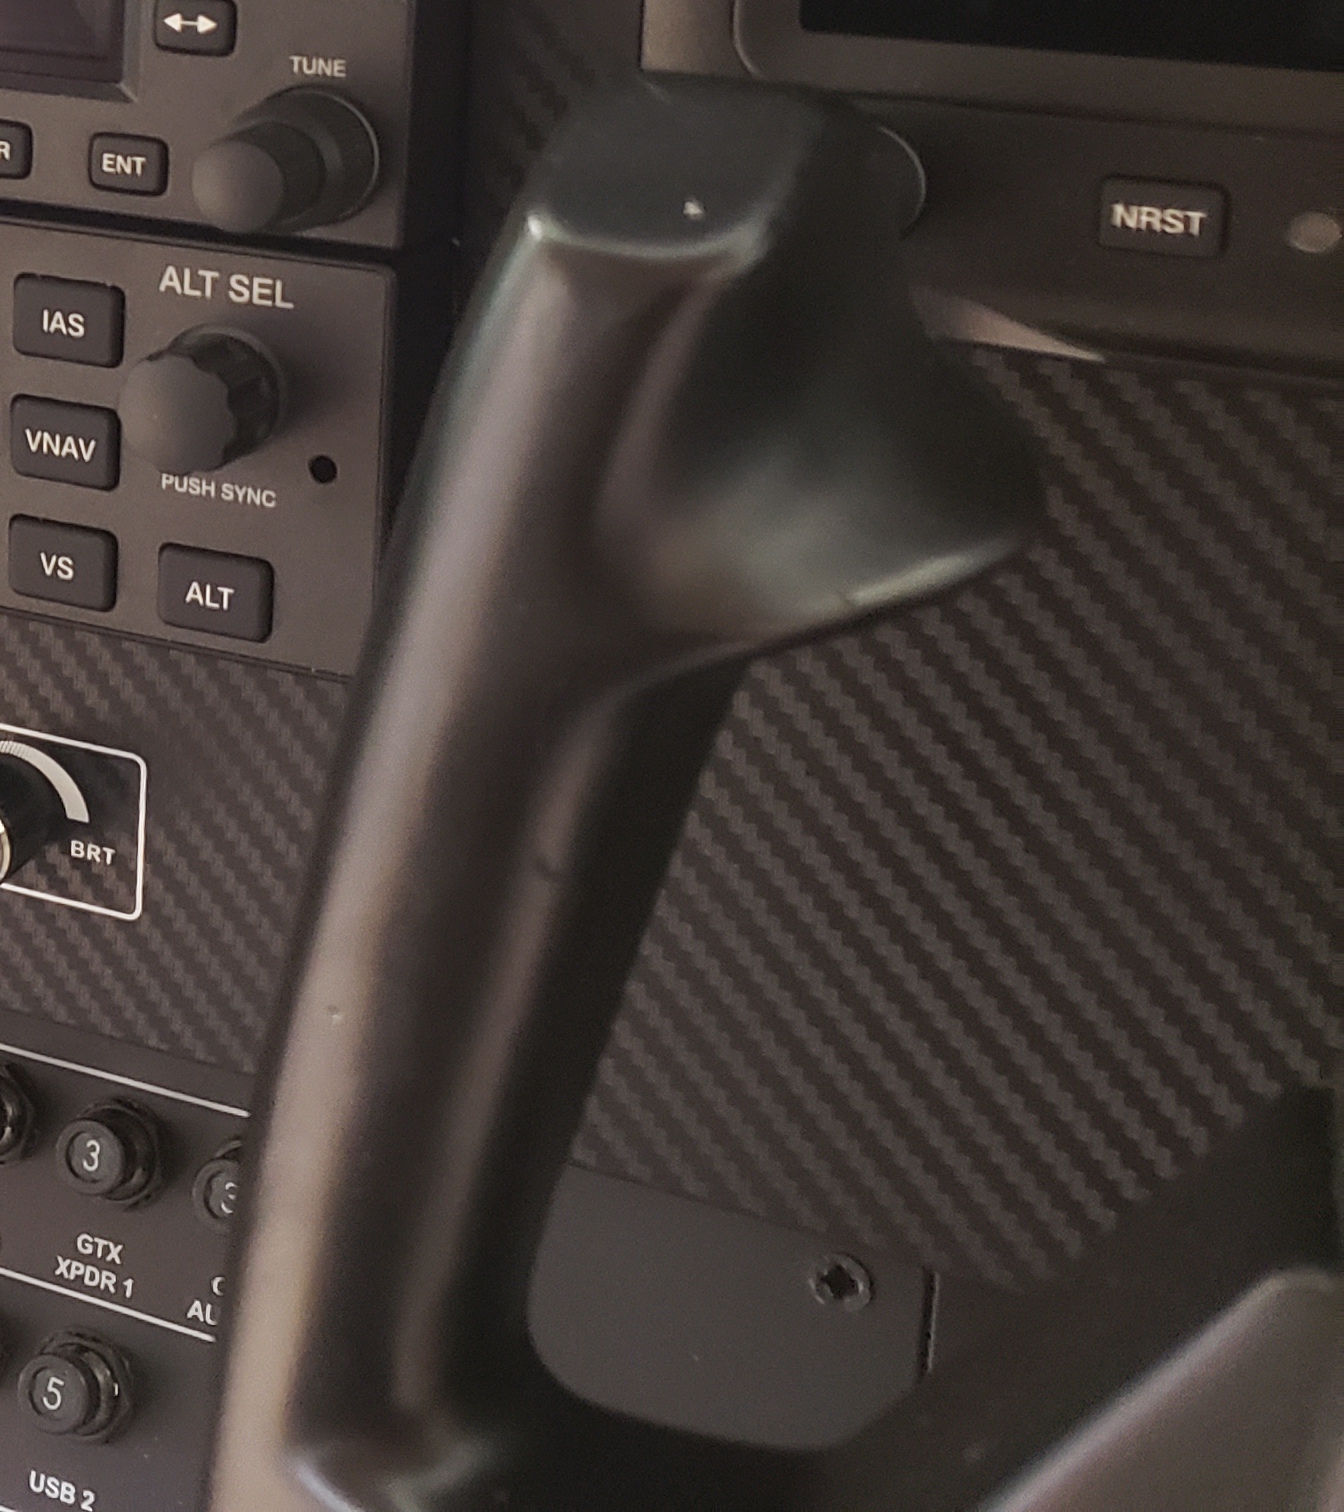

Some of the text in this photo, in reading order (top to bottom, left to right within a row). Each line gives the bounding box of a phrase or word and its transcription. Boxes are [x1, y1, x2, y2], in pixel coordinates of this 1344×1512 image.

[289, 55, 347, 78] TUNE
[102, 154, 146, 178] ENT
[1111, 201, 1207, 237] NRST
[158, 265, 294, 309] ALT SEL
[42, 309, 85, 338] IAS
[25, 429, 96, 463] VNAV
[161, 473, 277, 508] PUSH SYNC
[39, 552, 75, 580] VS
[185, 581, 234, 611] ALT
[70, 840, 116, 866] BRT
[83, 1139, 101, 1172] 3
[76, 1233, 124, 1265] GTX
[54, 1255, 135, 1299] XPDR 1
[42, 1377, 65, 1410] 5
[28, 1469, 97, 1512] USB 2
